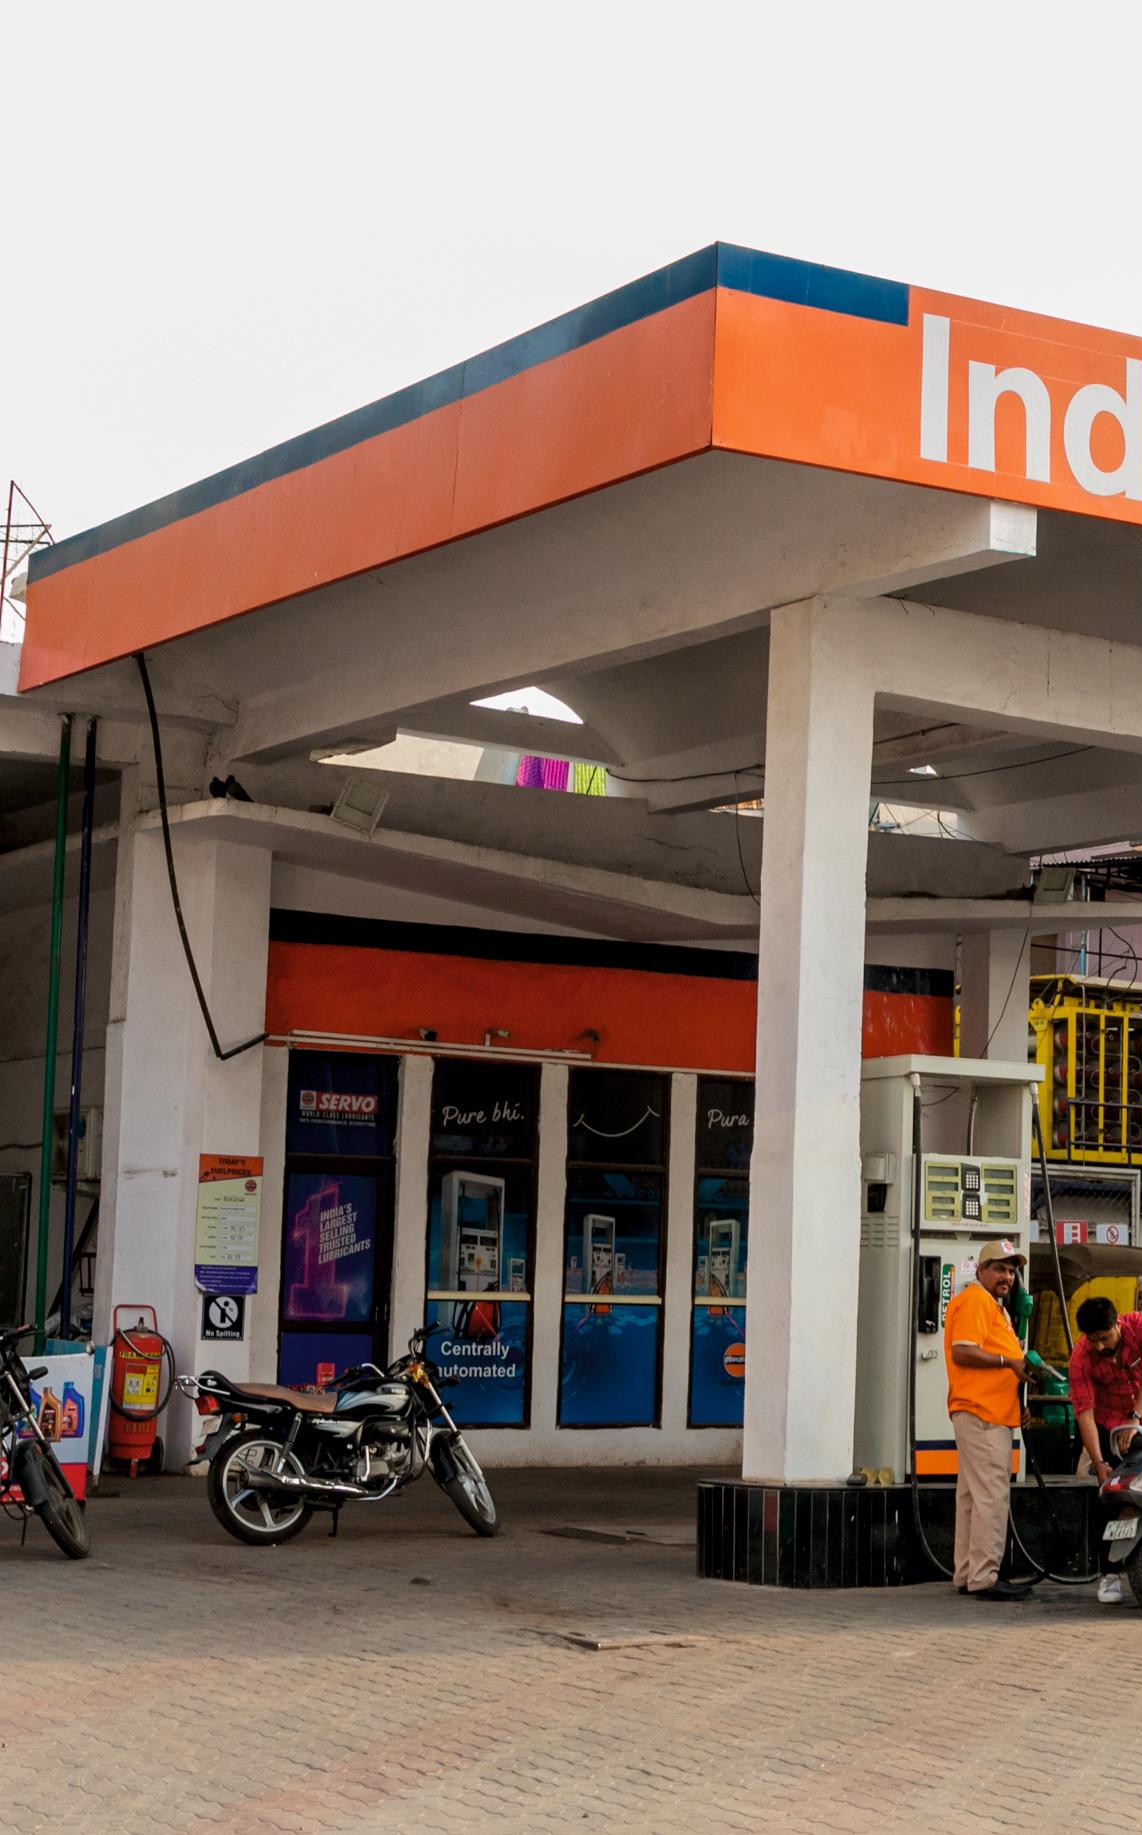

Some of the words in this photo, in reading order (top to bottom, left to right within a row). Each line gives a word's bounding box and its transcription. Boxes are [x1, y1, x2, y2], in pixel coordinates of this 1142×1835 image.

[319, 1093, 376, 1112] SERVO
[442, 1105, 487, 1127] Pure
[707, 1108, 750, 1129] Pura
[320, 1203, 353, 1222] INDIA'S
[320, 1211, 358, 1233] LARGEST
[319, 1233, 357, 1254] TRUSTED
[320, 1224, 355, 1244] SELLING
[318, 1238, 371, 1265] LUBRICANTS
[205, 1329, 214, 1337] No
[215, 1329, 240, 1338] Spitting
[440, 1341, 510, 1360] Centrally
